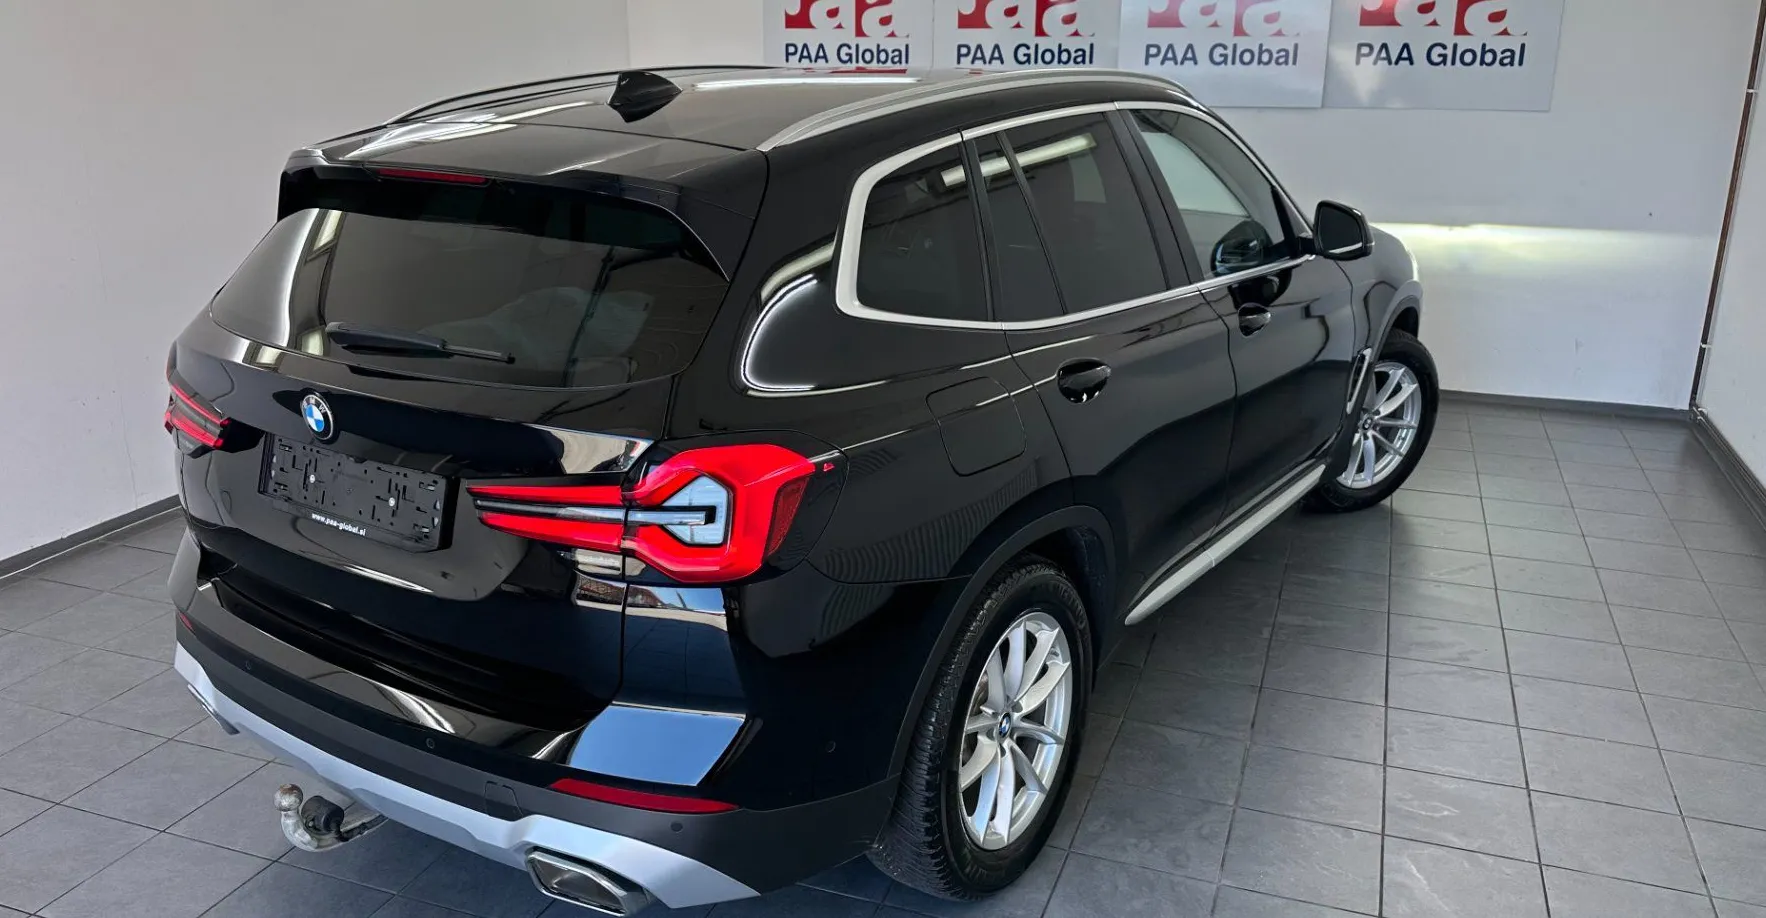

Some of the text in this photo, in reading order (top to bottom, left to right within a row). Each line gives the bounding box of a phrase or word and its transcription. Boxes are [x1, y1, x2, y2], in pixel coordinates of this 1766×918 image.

[785, 43, 909, 64] PAA Global
[956, 43, 1094, 65] PAA Global
[1144, 43, 1299, 66] PAA Global
[1355, 42, 1526, 67] PAA Global
[311, 513, 366, 536] www.paa-global.si
